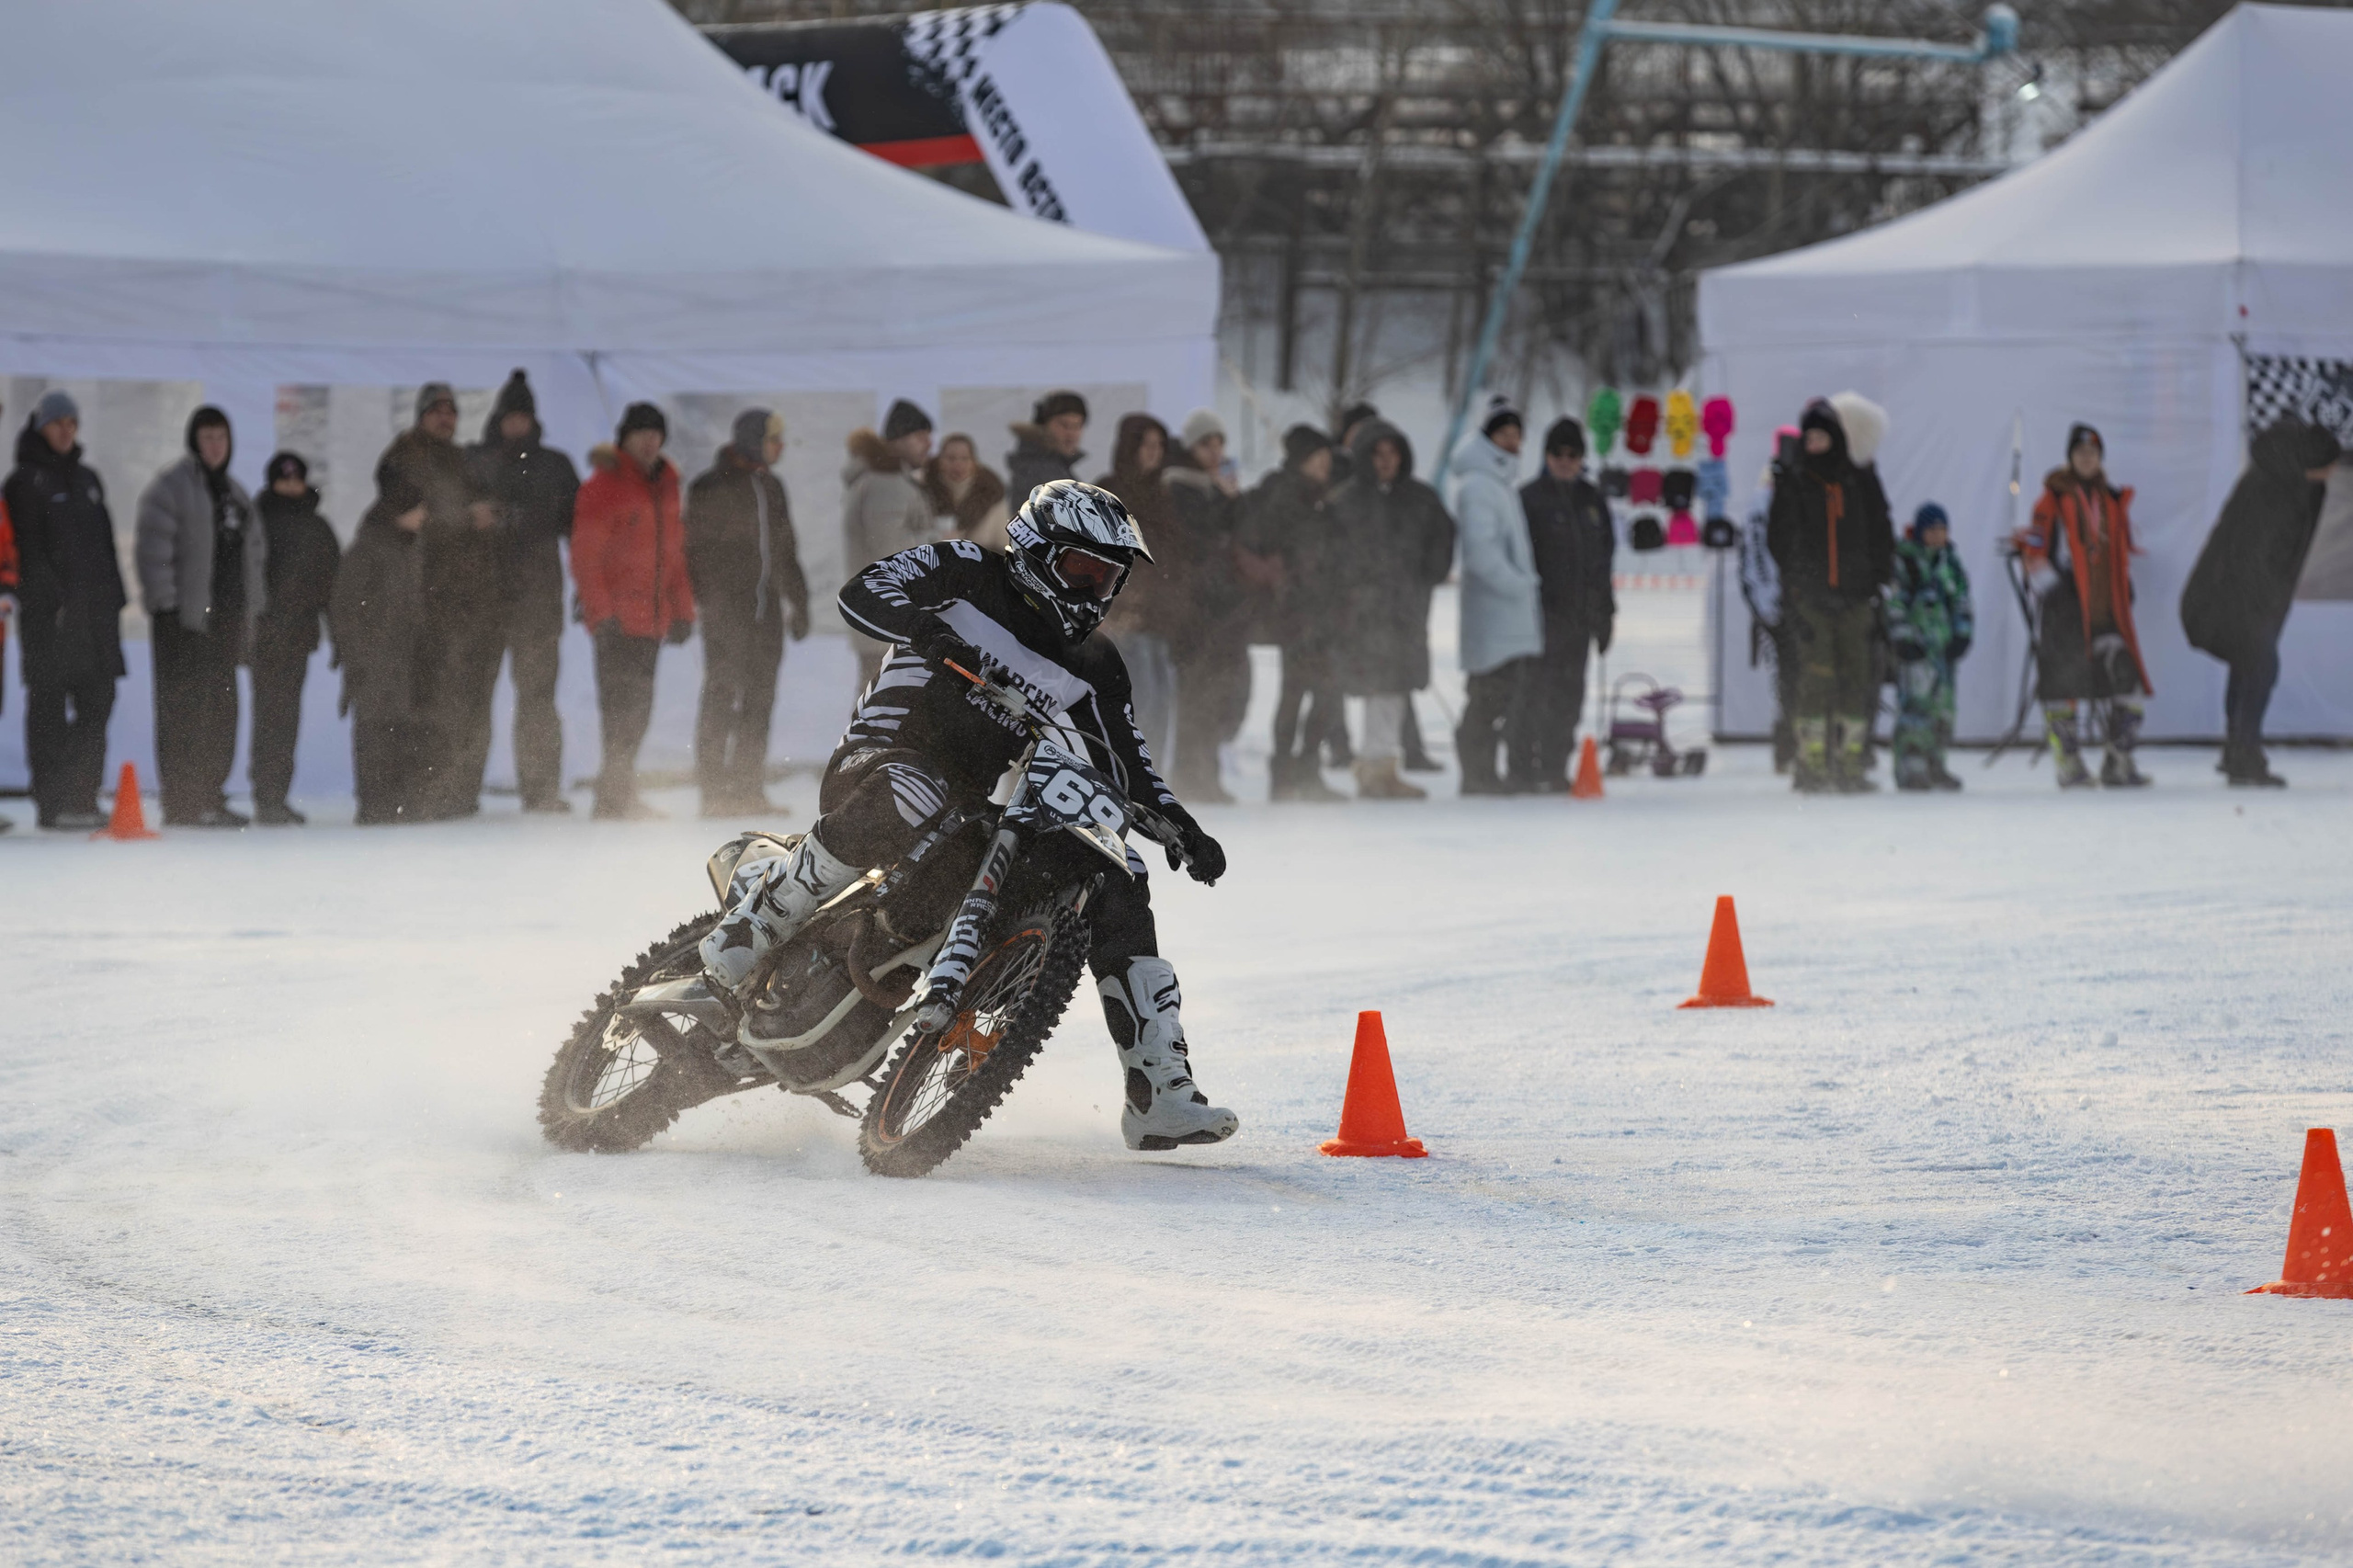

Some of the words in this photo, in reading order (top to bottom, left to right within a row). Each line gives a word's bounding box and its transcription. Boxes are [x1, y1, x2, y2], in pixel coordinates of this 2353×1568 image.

[1017, 158, 1072, 222] ВСТР
[1041, 769, 1124, 833] 69
[1049, 811, 1066, 824] US
